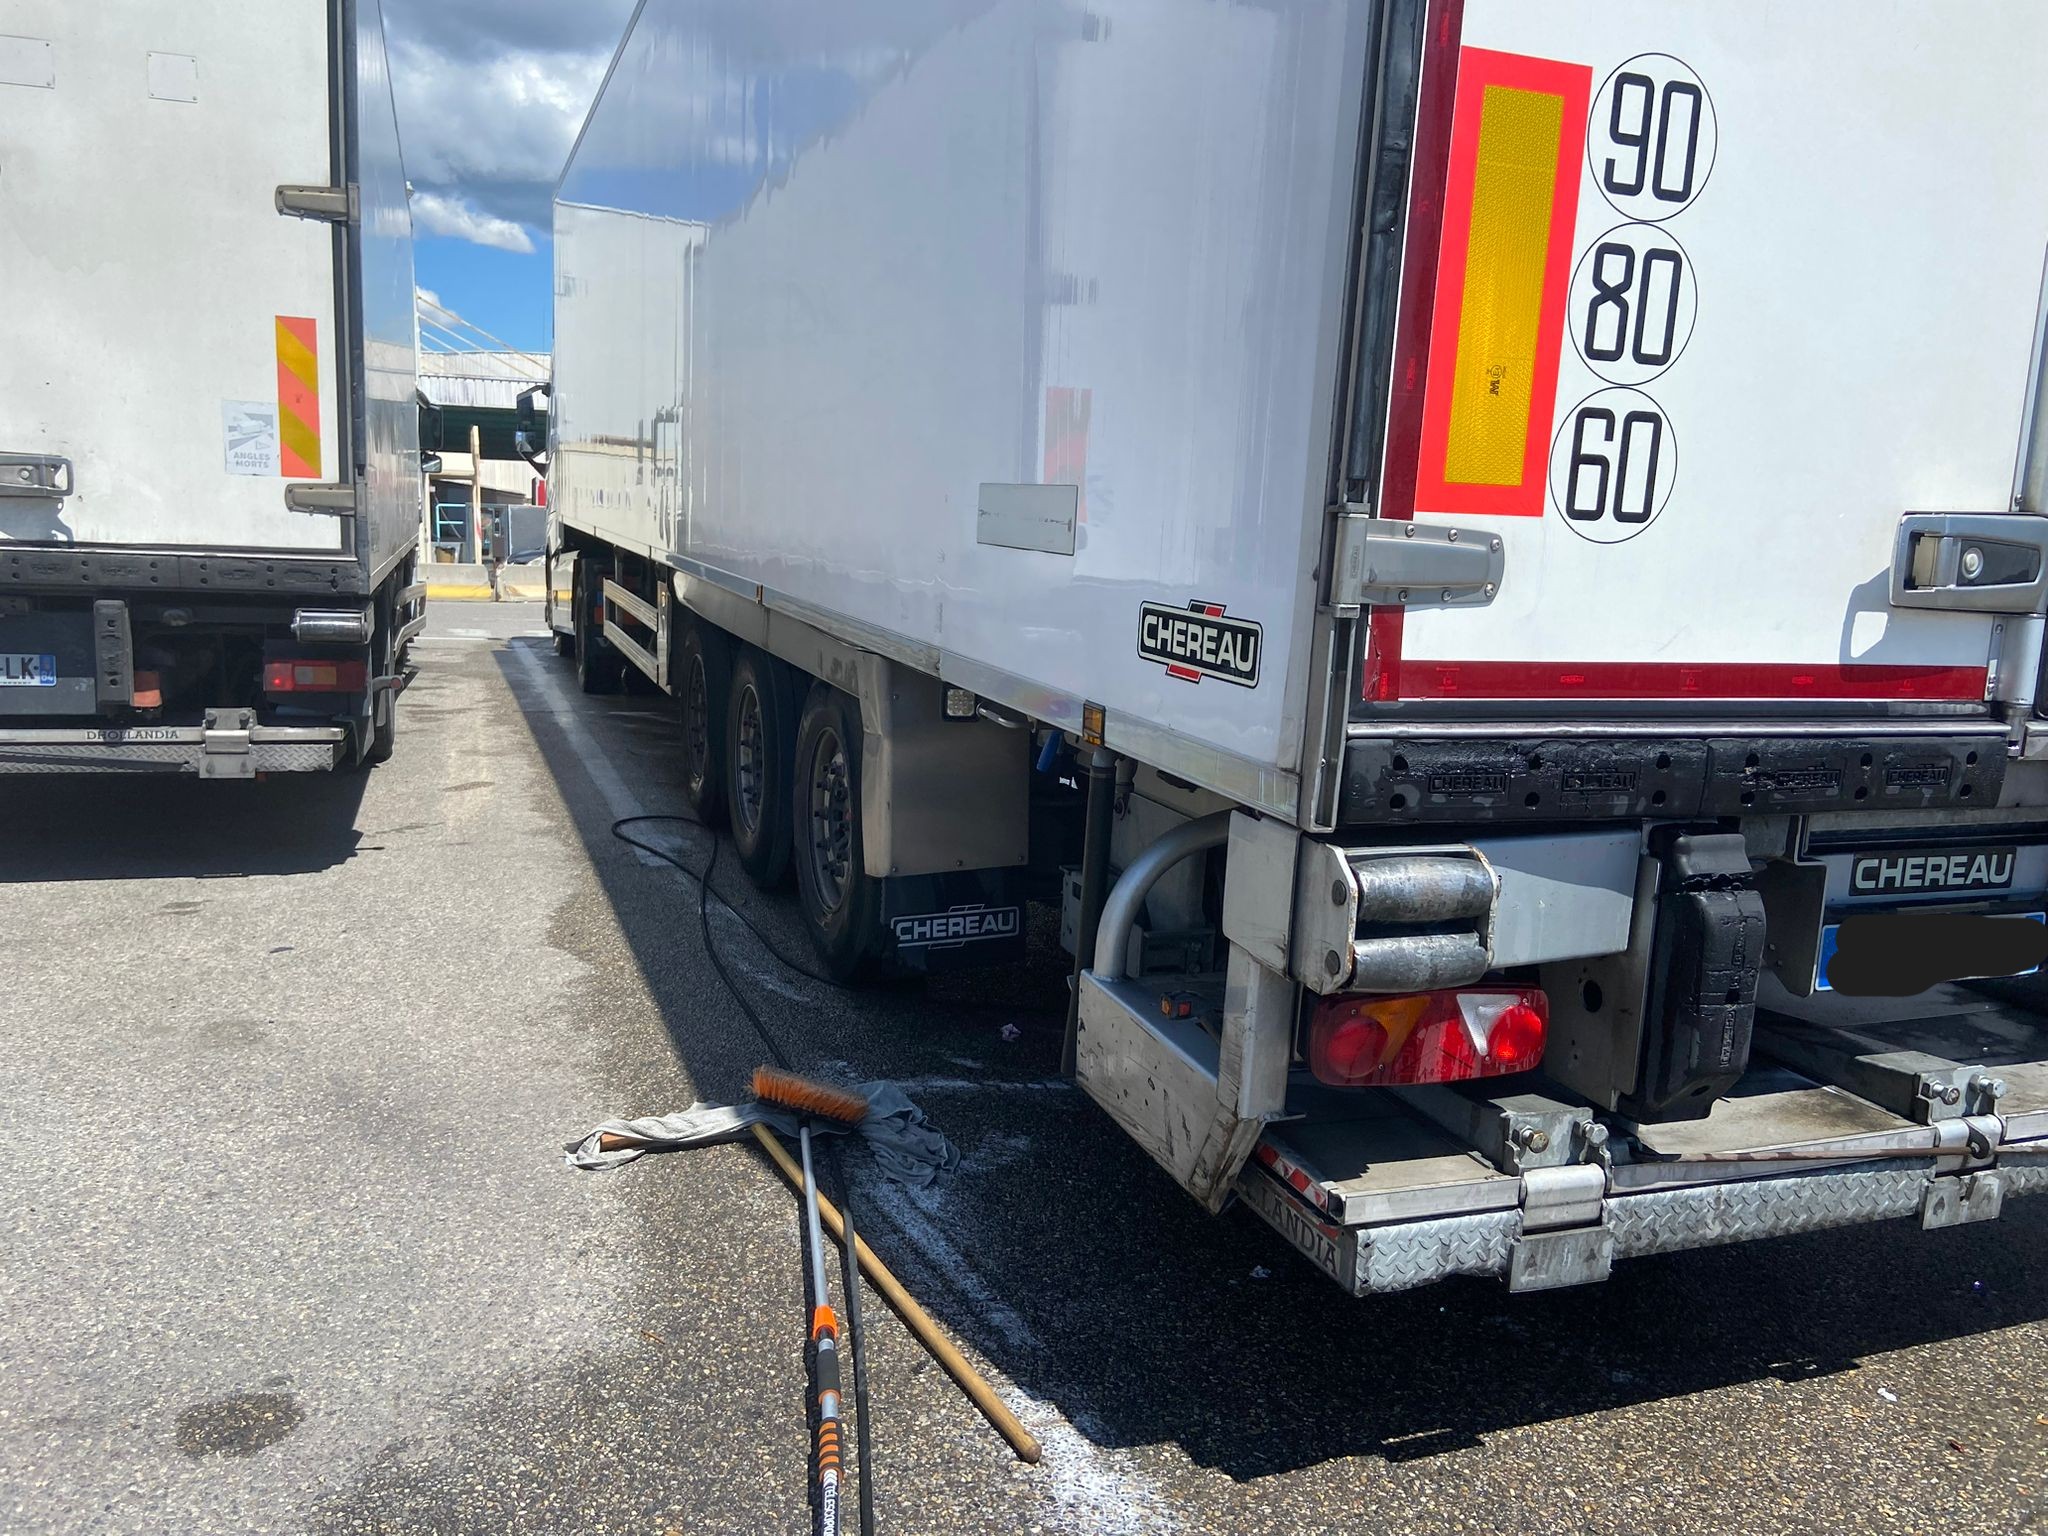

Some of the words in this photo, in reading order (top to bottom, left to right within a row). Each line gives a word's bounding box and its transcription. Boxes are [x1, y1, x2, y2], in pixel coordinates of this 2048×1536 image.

[1604, 72, 1702, 203] 90
[1584, 242, 1682, 366] 80
[233, 452, 271, 461] ANGLES
[235, 460, 270, 469] MORTS
[1565, 406, 1662, 523] 60
[1143, 614, 1255, 672] CHEREAU
[86, 730, 179, 740] DHOLLANDIA
[1855, 853, 2013, 889] CHEREAU
[896, 912, 1014, 940] CHEREAU
